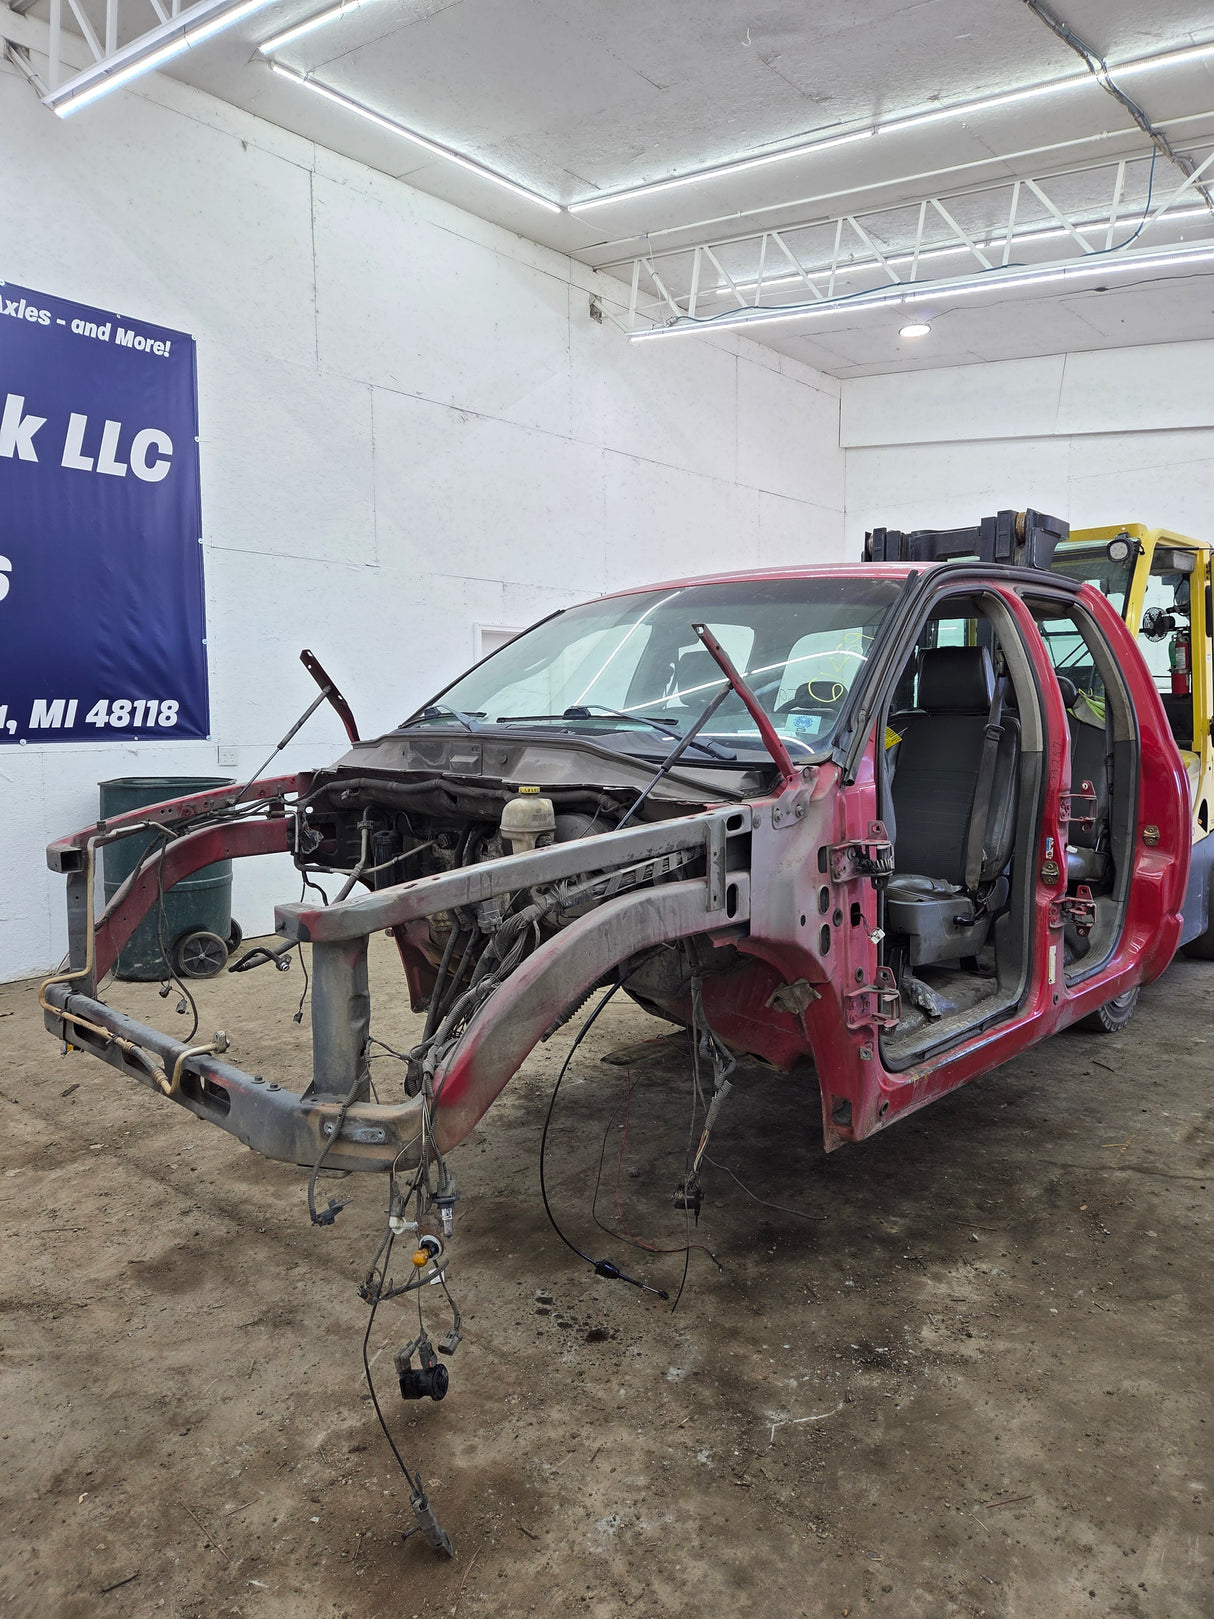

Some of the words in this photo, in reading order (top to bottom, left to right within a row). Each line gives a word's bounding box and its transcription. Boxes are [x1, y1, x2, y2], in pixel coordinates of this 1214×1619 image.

[0, 294, 51, 325] xles
[71, 317, 111, 342] and
[115, 327, 171, 357] More!
[61, 412, 173, 482] LLC
[29, 699, 78, 728] MI
[85, 699, 179, 728] 48118
